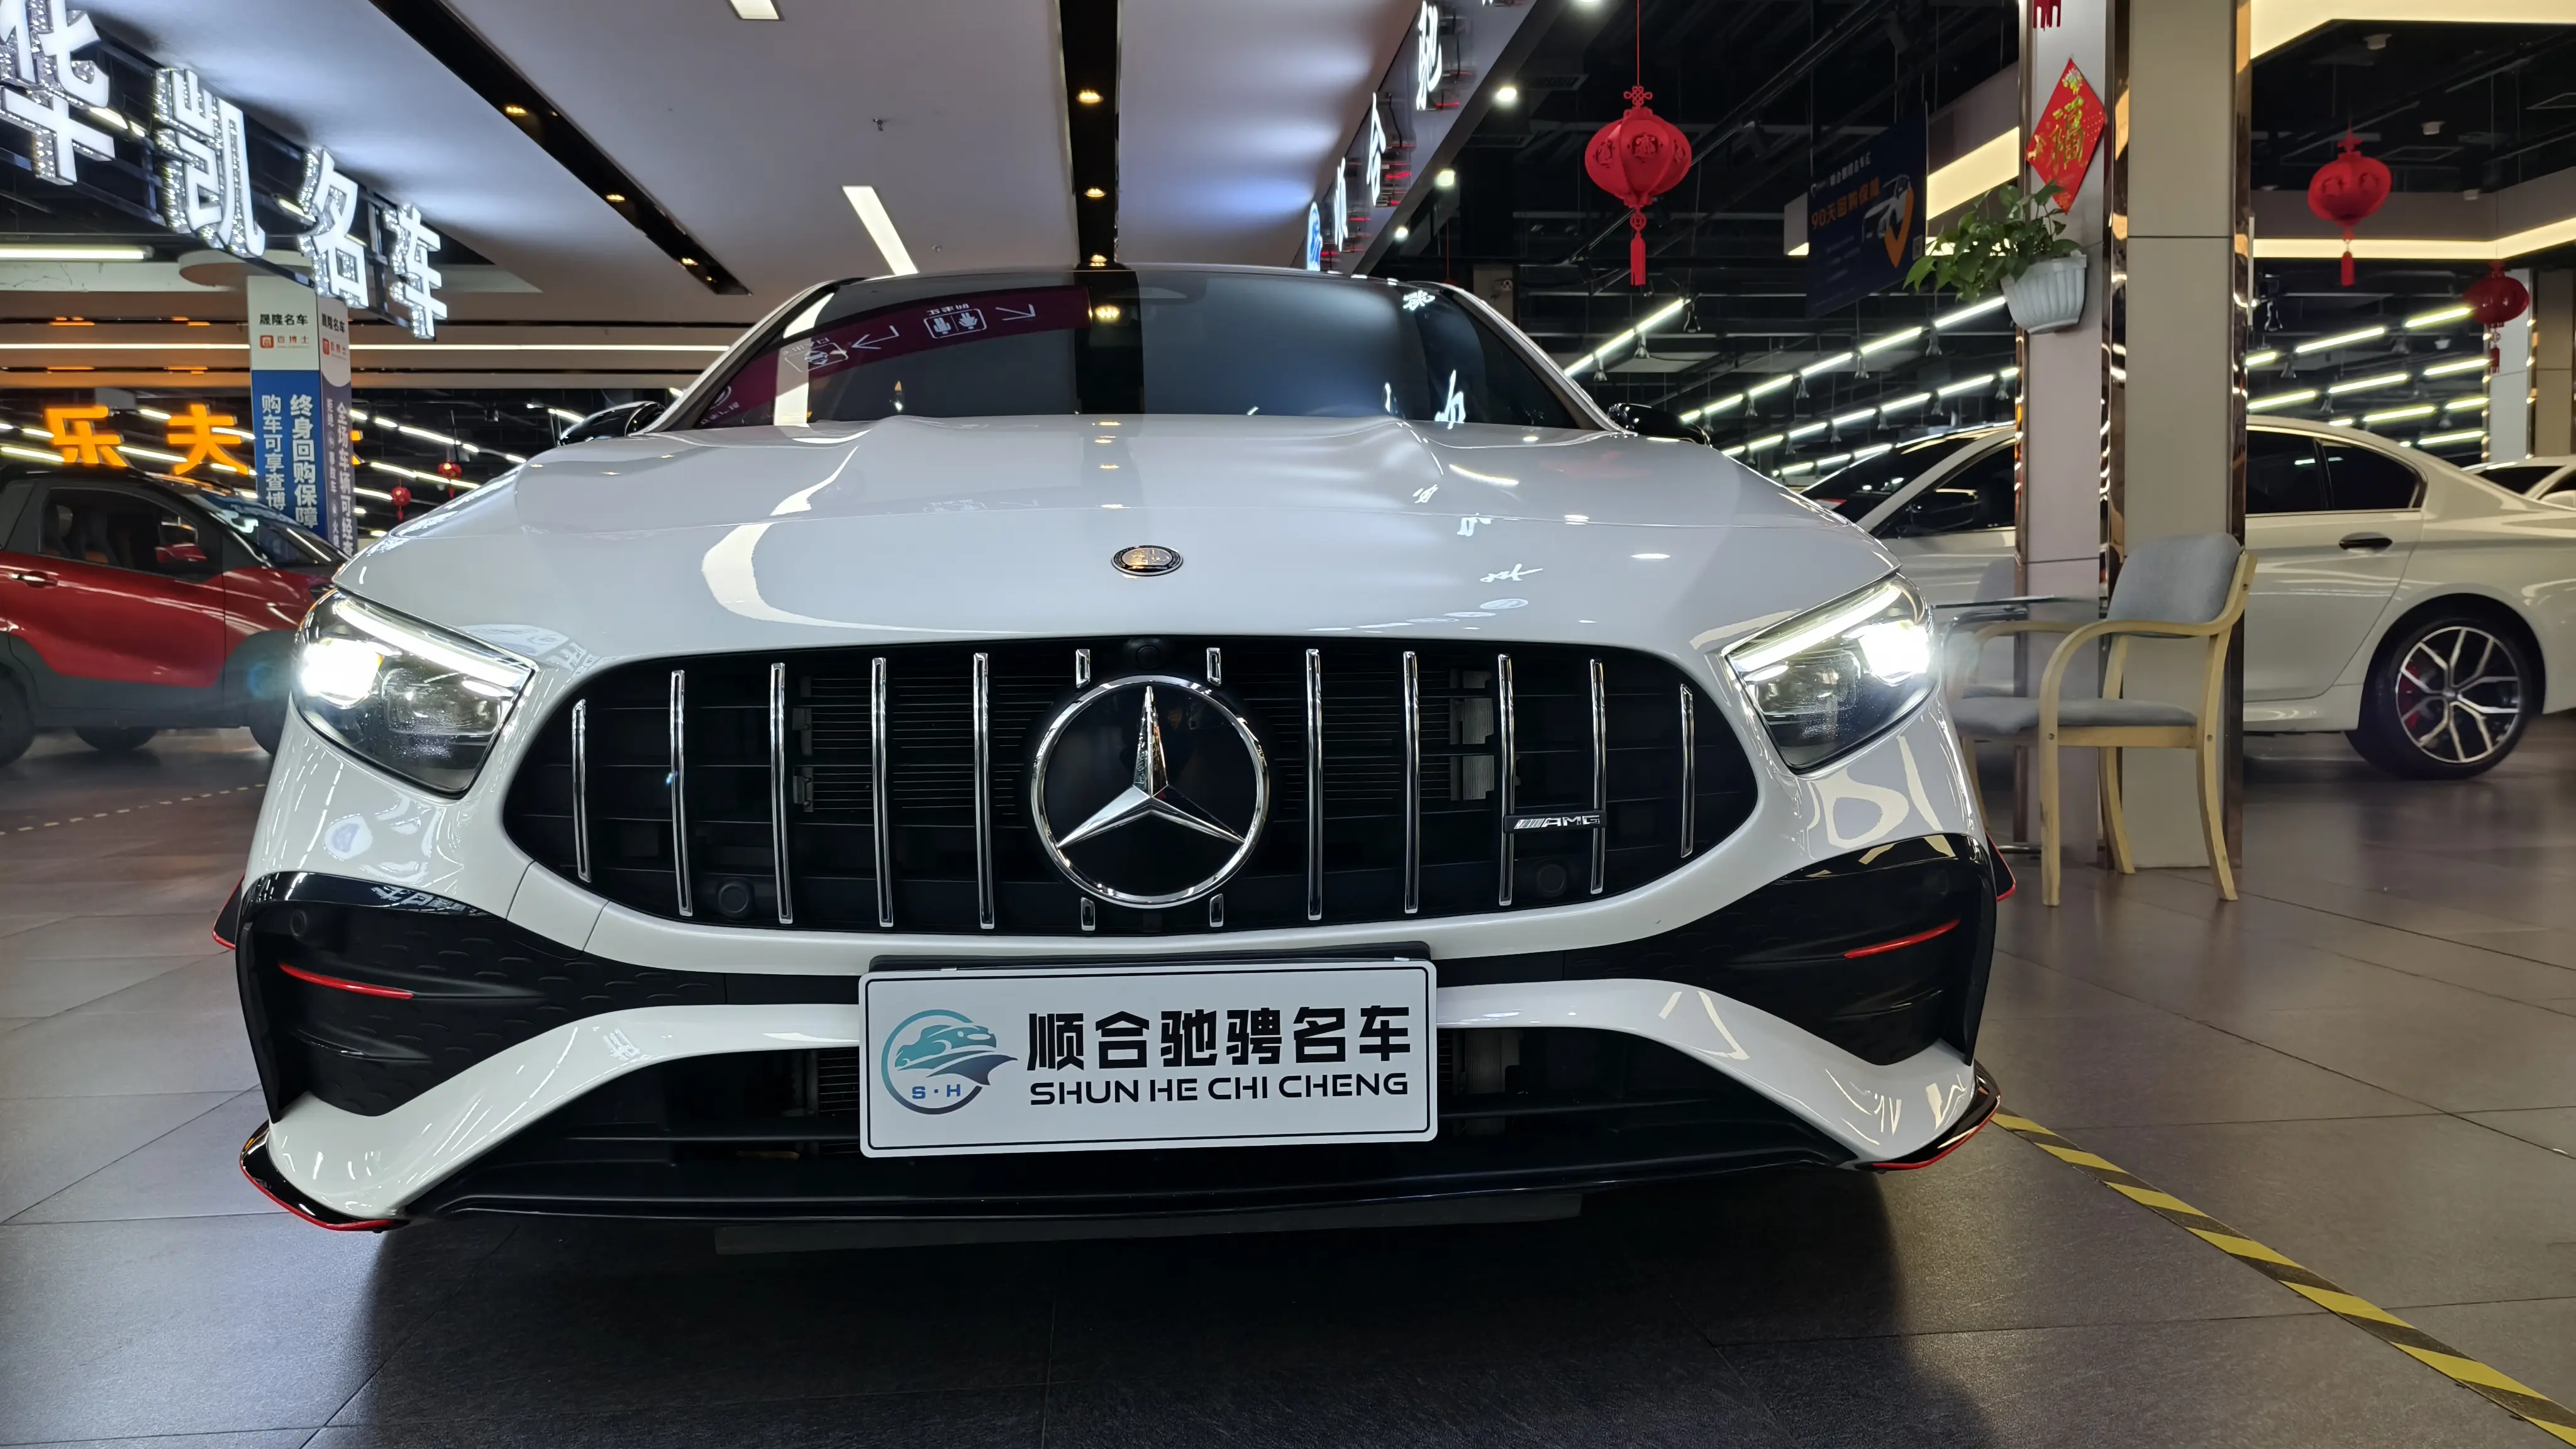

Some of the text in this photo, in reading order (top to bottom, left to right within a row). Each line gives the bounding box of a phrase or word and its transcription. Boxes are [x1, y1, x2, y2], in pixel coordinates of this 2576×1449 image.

[260, 313, 308, 326] 晟隆名车
[290, 394, 318, 529] 终身回购保障
[1541, 815, 1601, 828] AMG
[1026, 1005, 1411, 1072] 顺合驰骋名车
[1030, 1072, 1409, 1106] SHUN HE CHI CHENG
